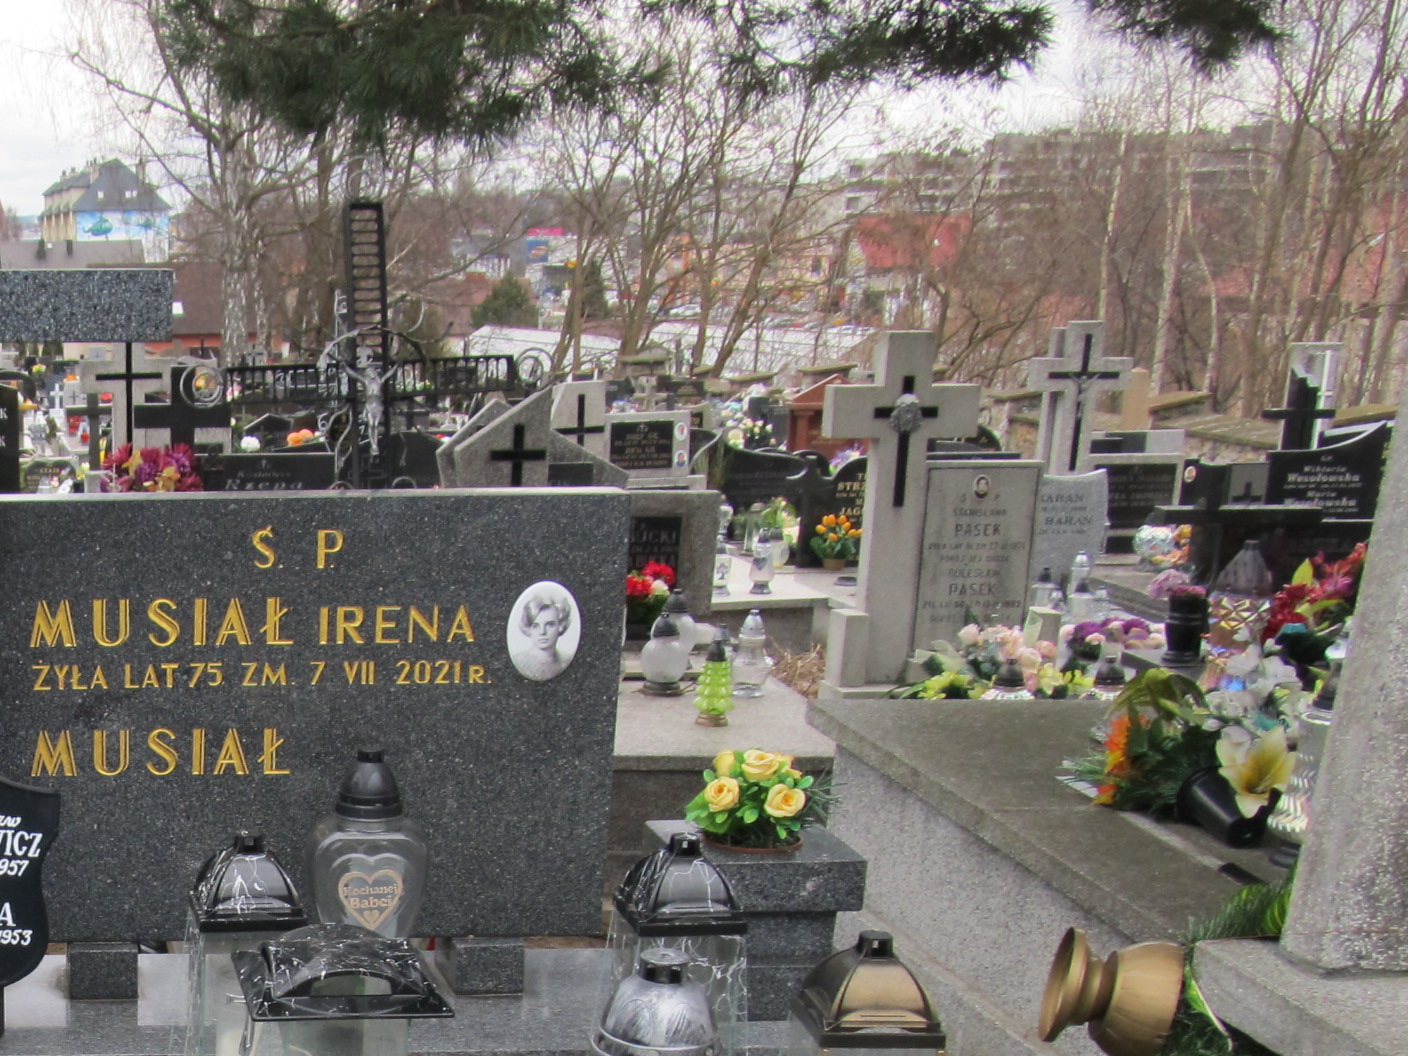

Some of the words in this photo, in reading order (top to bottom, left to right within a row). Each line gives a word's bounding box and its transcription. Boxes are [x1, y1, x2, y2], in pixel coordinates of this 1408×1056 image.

[955, 524, 1002, 537] PASEK
[948, 584, 997, 597] PASEK
[29, 596, 294, 648] MUSIAŁ
[318, 604, 476, 646] IRENA
[32, 659, 108, 692] ŻYŁA
[124, 663, 180, 690] LAT
[187, 662, 223, 688] 75
[241, 662, 294, 687] ZM.
[310, 661, 326, 686] 7
[343, 660, 376, 685] VII
[30, 727, 291, 778] MUSIAŁ
[350, 895, 393, 908] Babci
